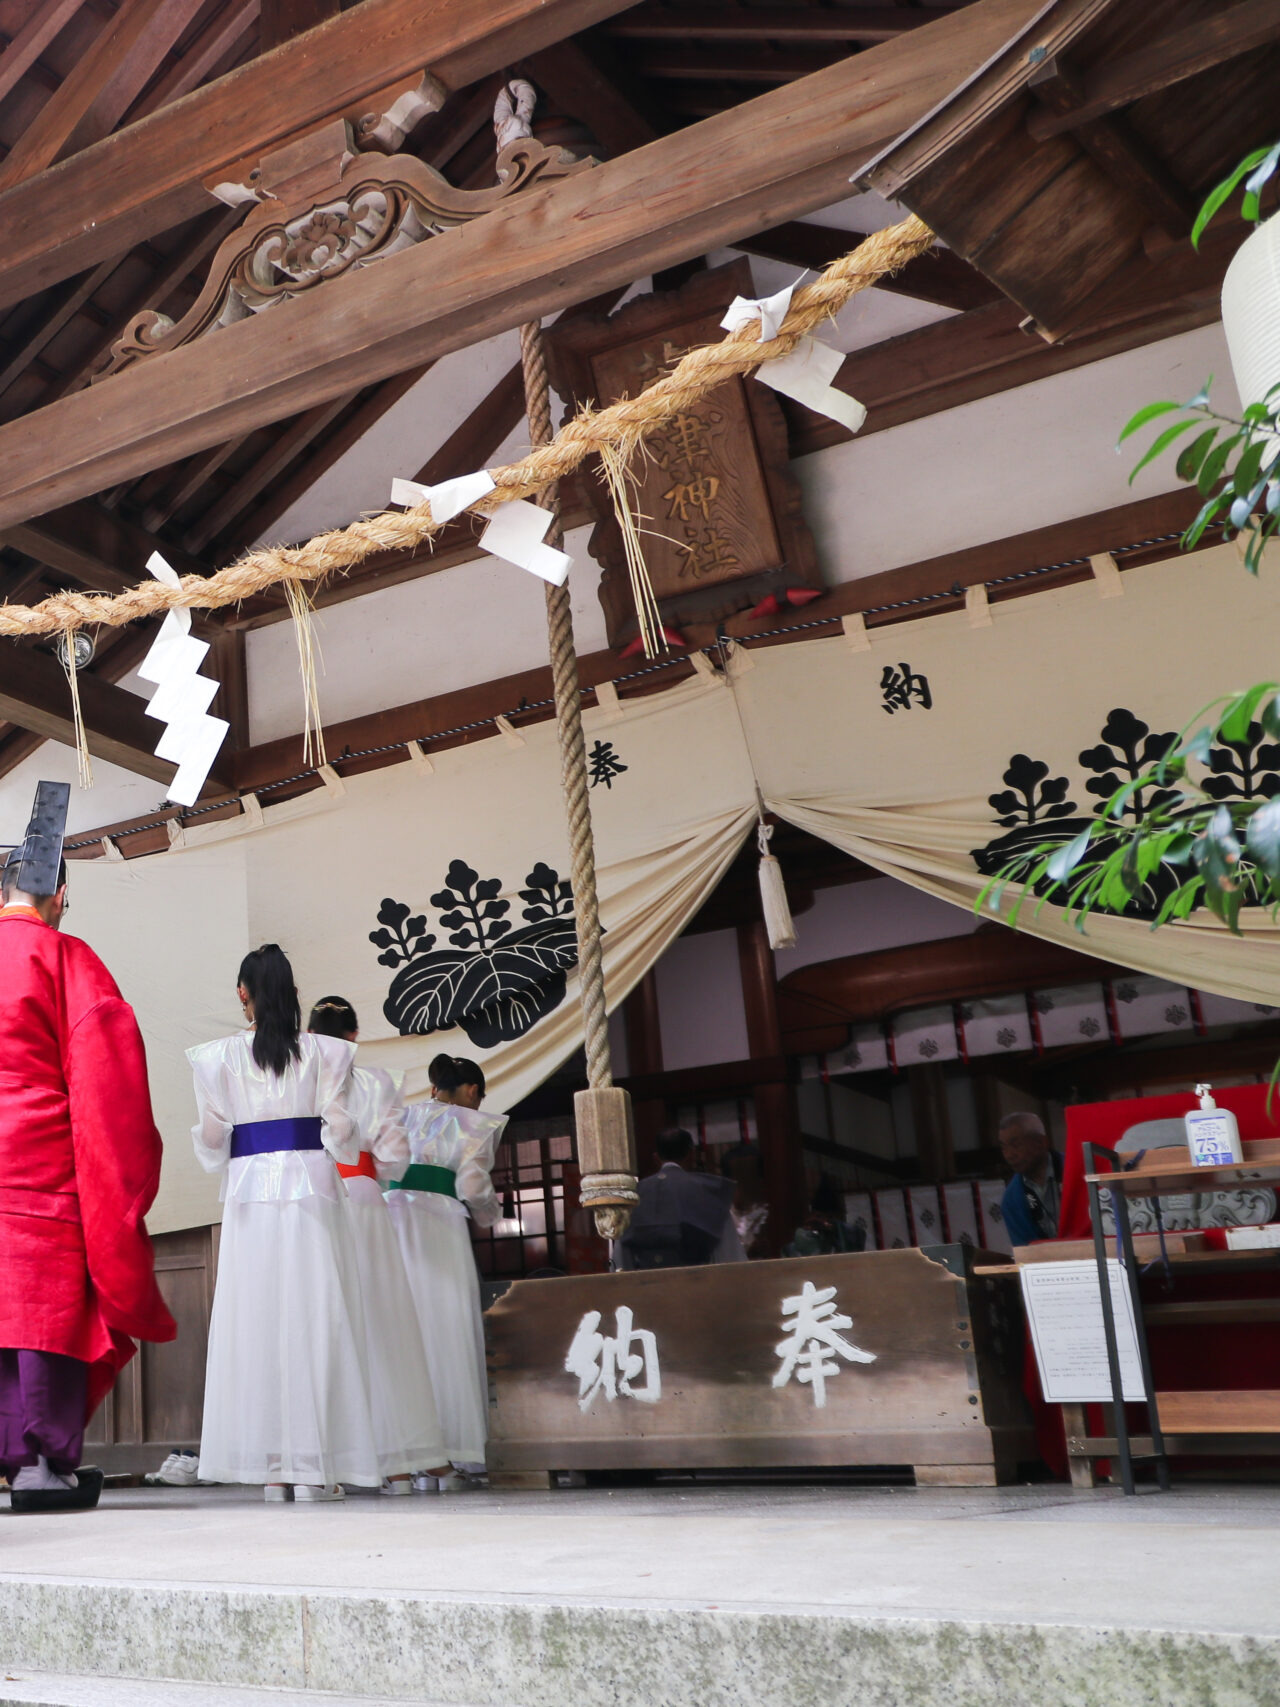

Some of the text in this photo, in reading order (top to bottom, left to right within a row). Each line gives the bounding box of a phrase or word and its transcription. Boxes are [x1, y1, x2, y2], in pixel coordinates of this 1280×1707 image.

[587, 662, 933, 790] 奉 納
[564, 1280, 878, 1414] 奉 納
